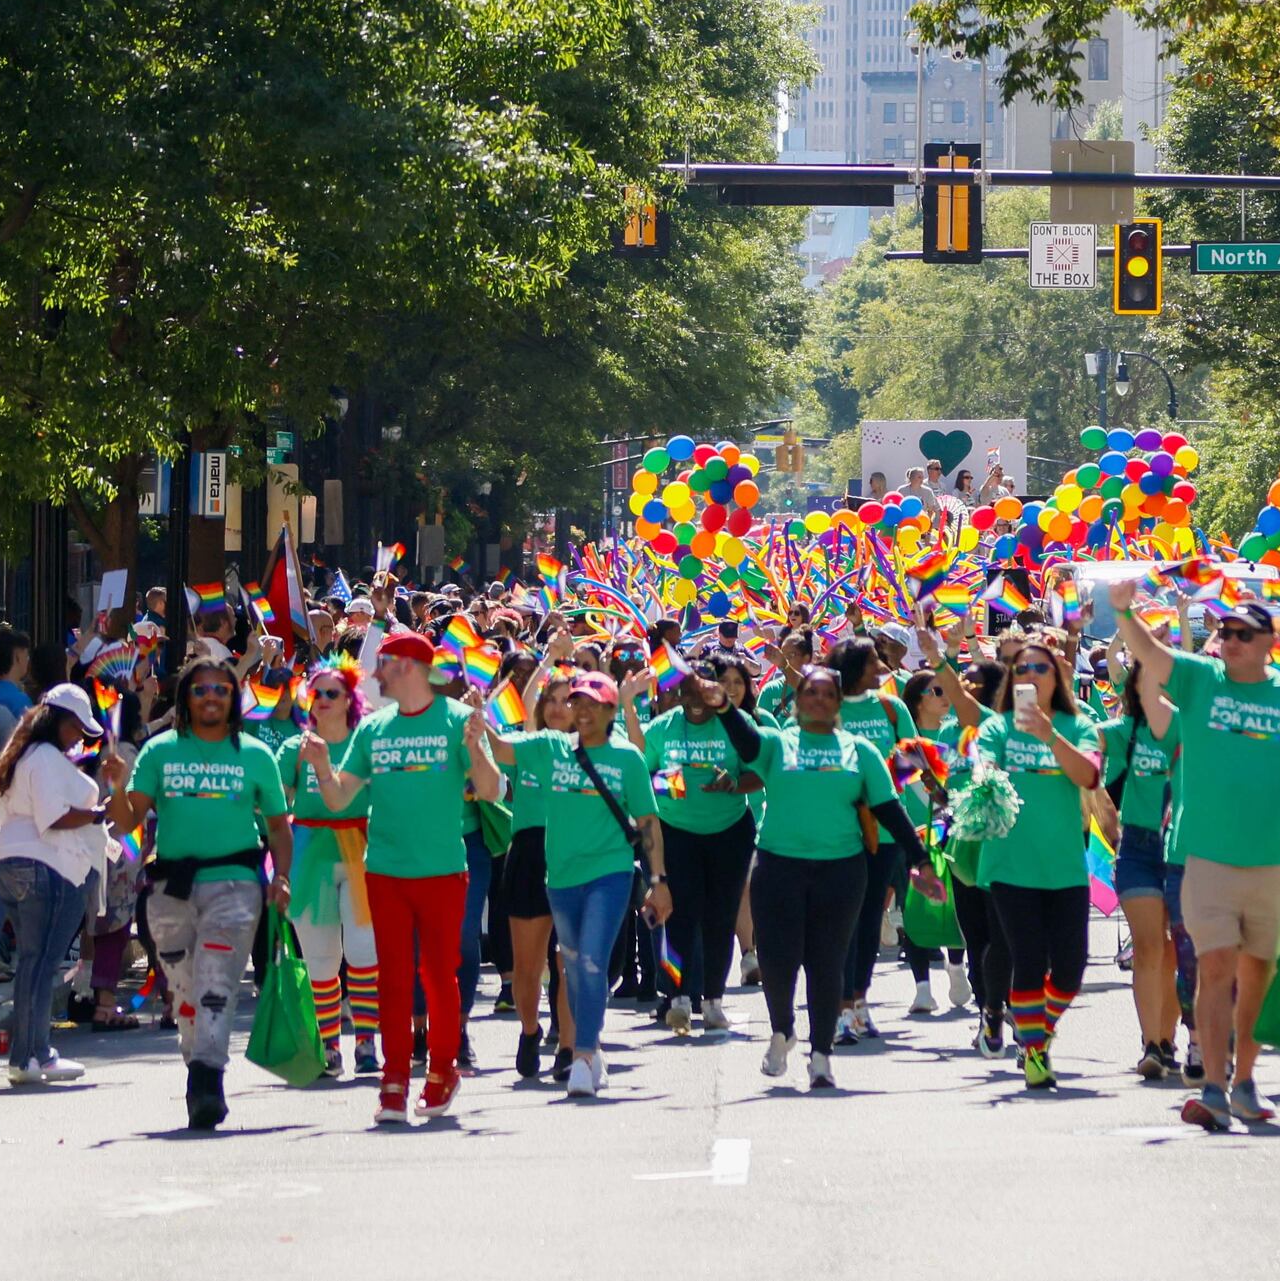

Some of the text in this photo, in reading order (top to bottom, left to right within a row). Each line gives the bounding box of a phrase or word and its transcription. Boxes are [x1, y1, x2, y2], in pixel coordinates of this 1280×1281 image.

[1062, 226, 1093, 236] BLOCK
[1211, 249, 1267, 266] North
[1035, 272, 1090, 286] THE BOX
[210, 455, 220, 498] marta
[1210, 706, 1275, 733] FOR ALL
[372, 735, 448, 749] BELONGING
[372, 750, 435, 765] FOR ALL
[690, 750, 716, 761] ALL
[1005, 752, 1036, 766] FOR
[163, 762, 245, 777] BELONGING
[163, 775, 231, 791] FOR ALL
[551, 771, 581, 787] FOR
